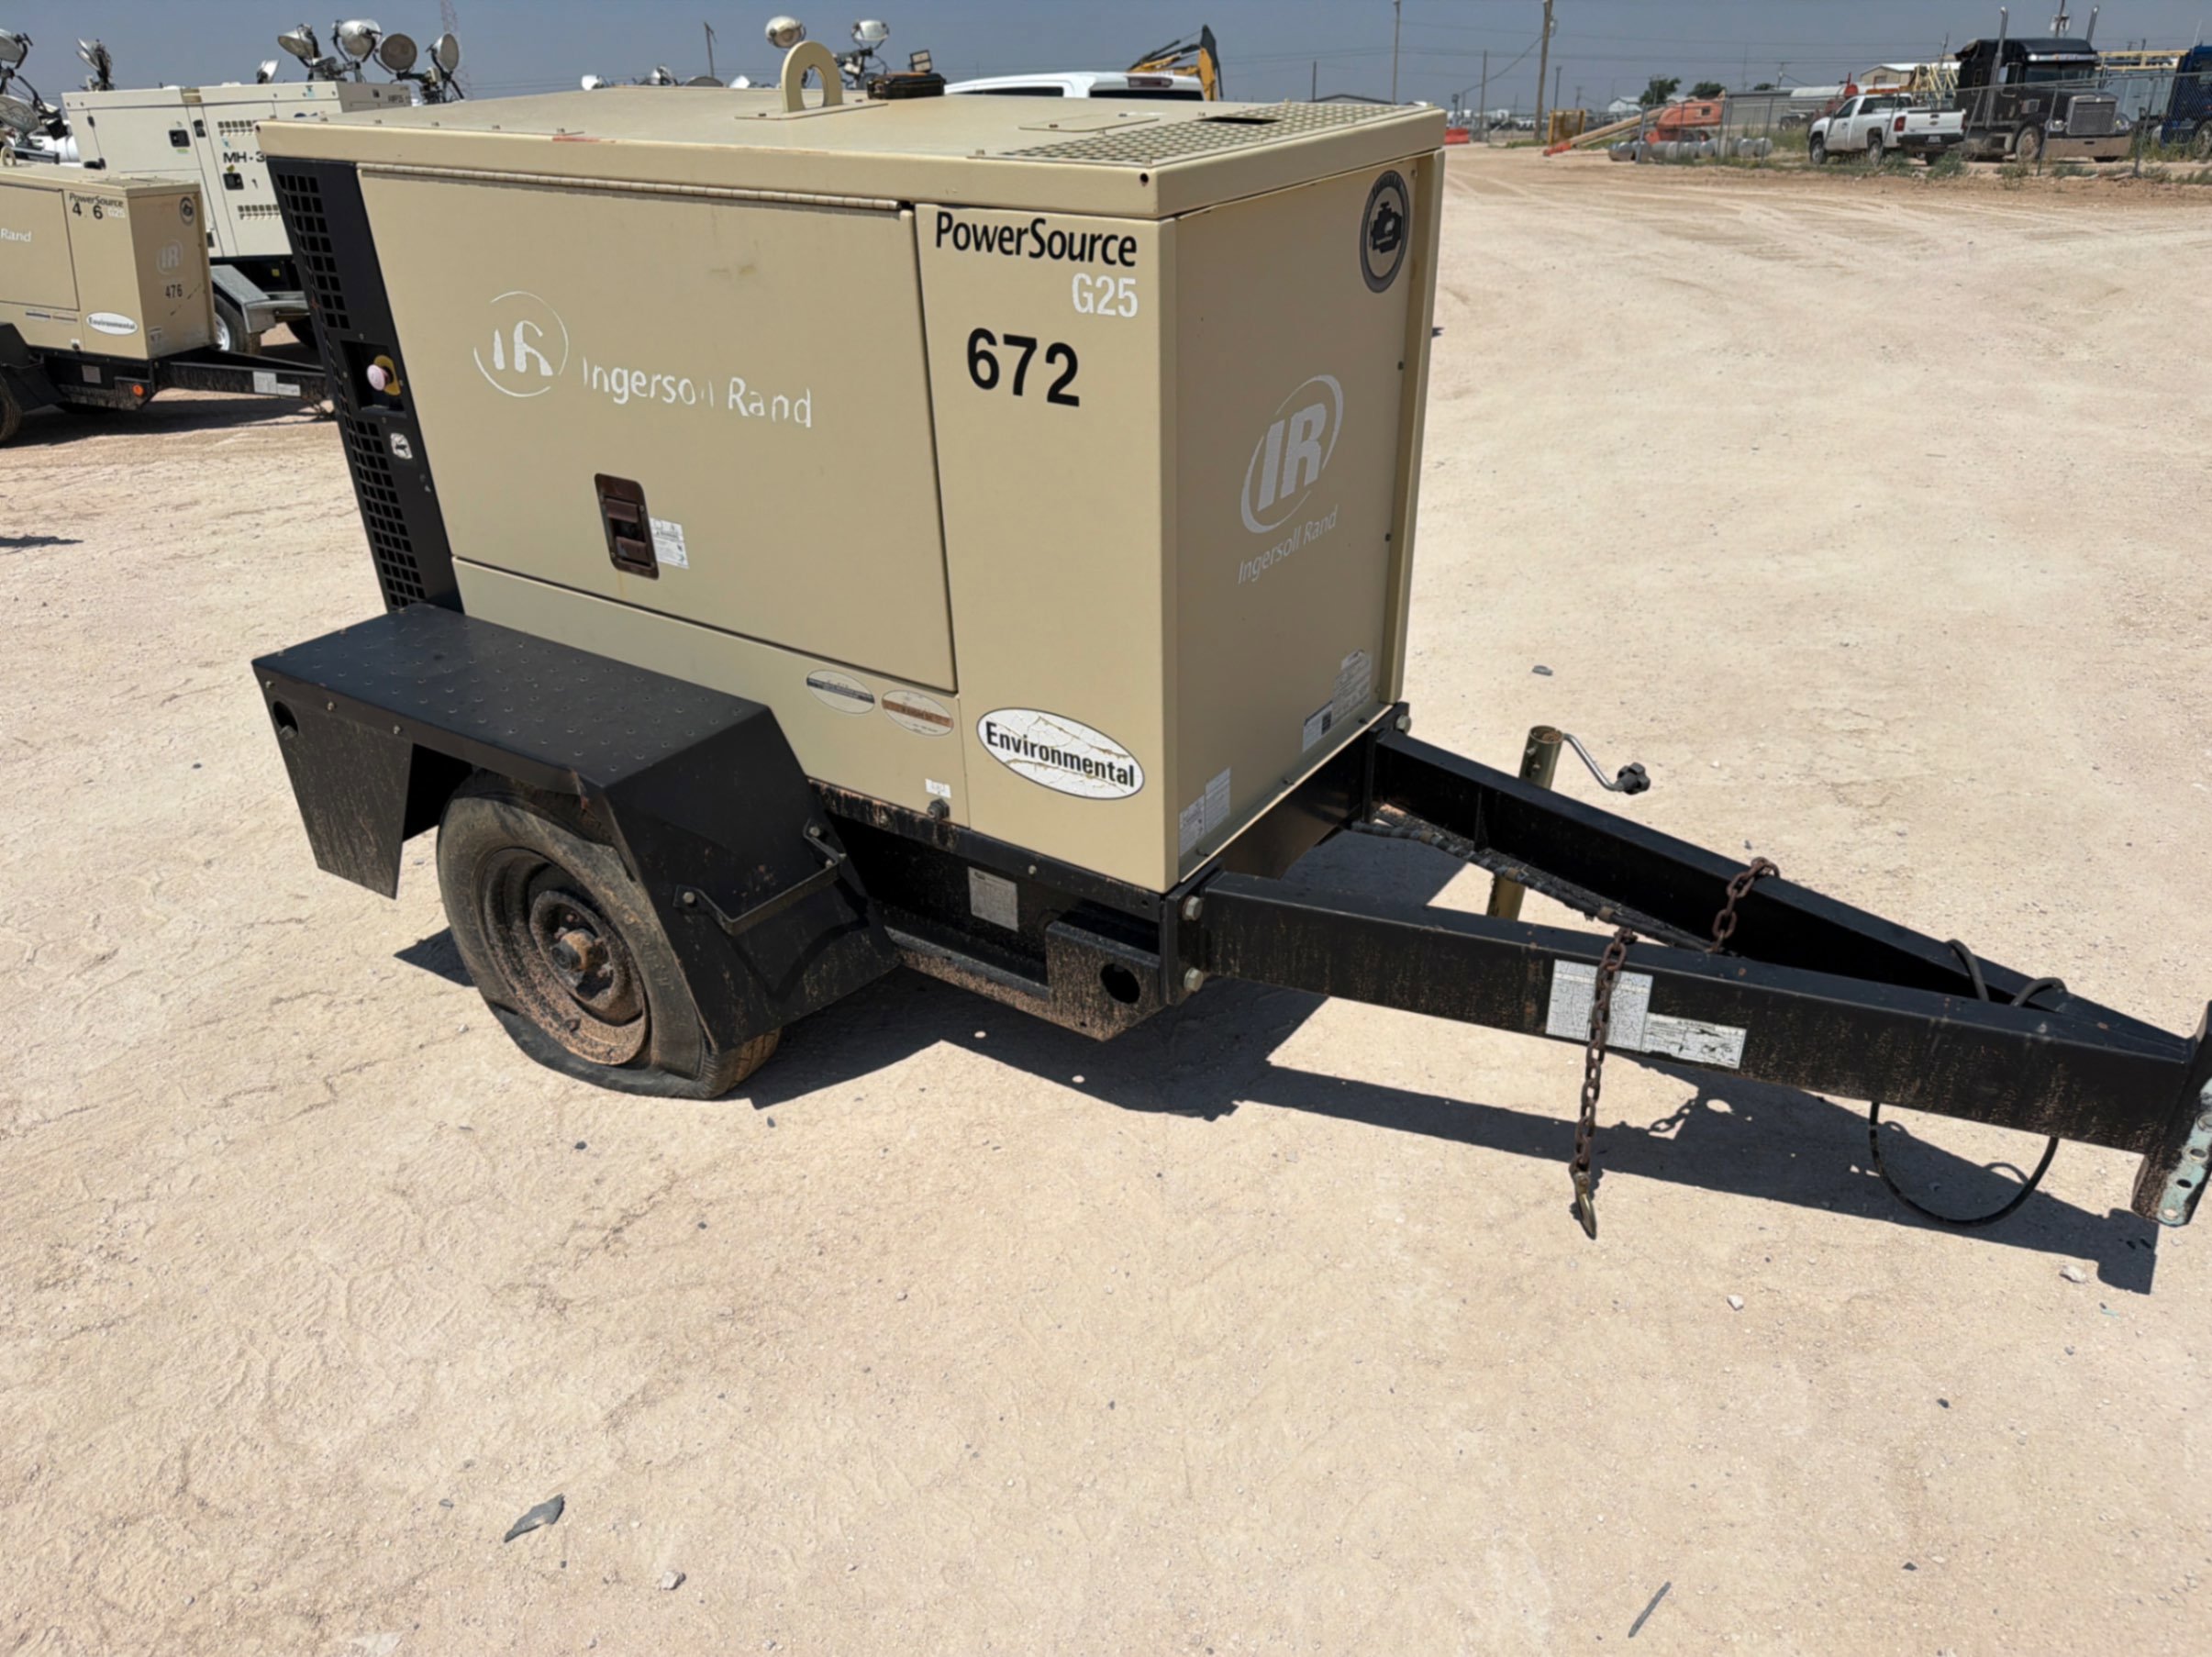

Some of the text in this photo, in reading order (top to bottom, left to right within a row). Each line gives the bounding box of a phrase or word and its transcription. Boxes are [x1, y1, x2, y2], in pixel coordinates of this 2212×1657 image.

[1, 228, 32, 242] Rand
[935, 211, 1138, 267] PowerSource
[165, 284, 183, 299] 476
[1072, 272, 1139, 317] G25
[967, 328, 1080, 407] 672
[728, 377, 812, 428] Rand
[1238, 504, 1339, 584] Ingersoll Rand
[985, 720, 1135, 787] Environmental
